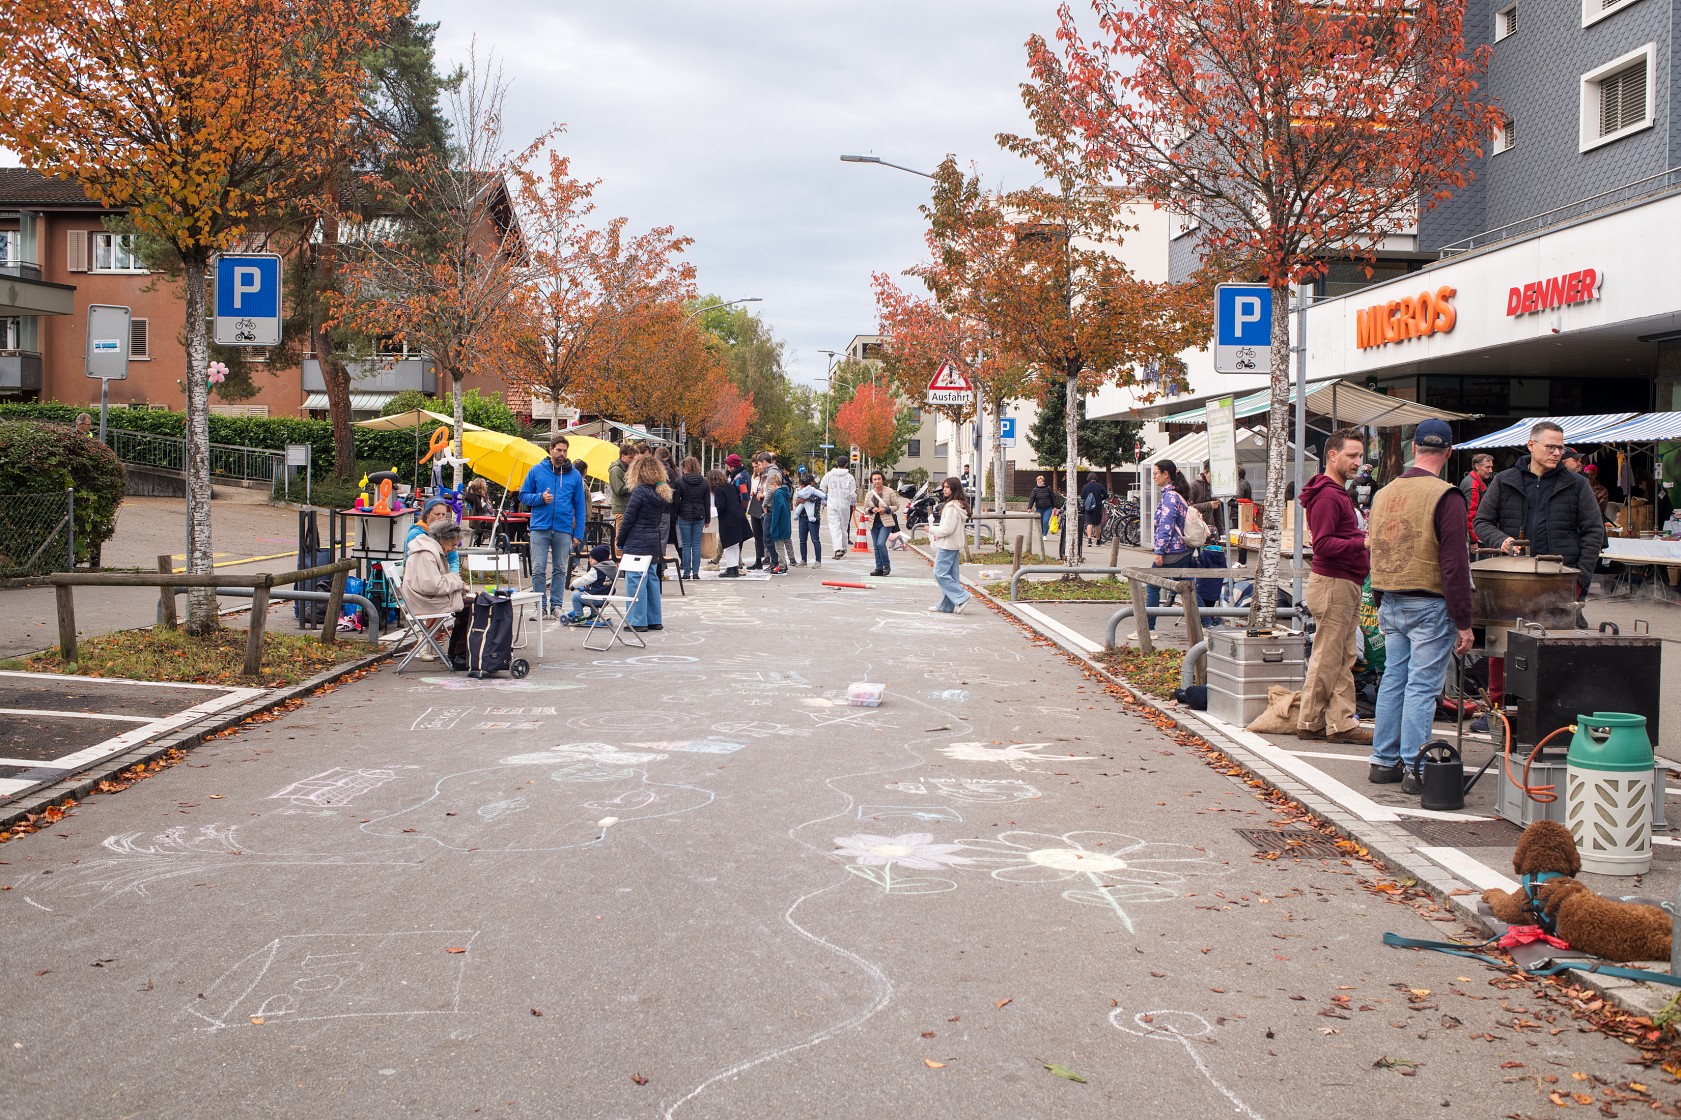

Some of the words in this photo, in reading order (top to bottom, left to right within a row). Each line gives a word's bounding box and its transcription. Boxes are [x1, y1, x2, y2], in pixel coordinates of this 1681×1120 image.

[234, 266, 261, 308] P
[1506, 268, 1603, 316] DENNER
[1234, 296, 1261, 338] P
[1356, 285, 1457, 350] MIGROS
[931, 392, 970, 402] Ausfahrt
[1000, 421, 1010, 436] P
